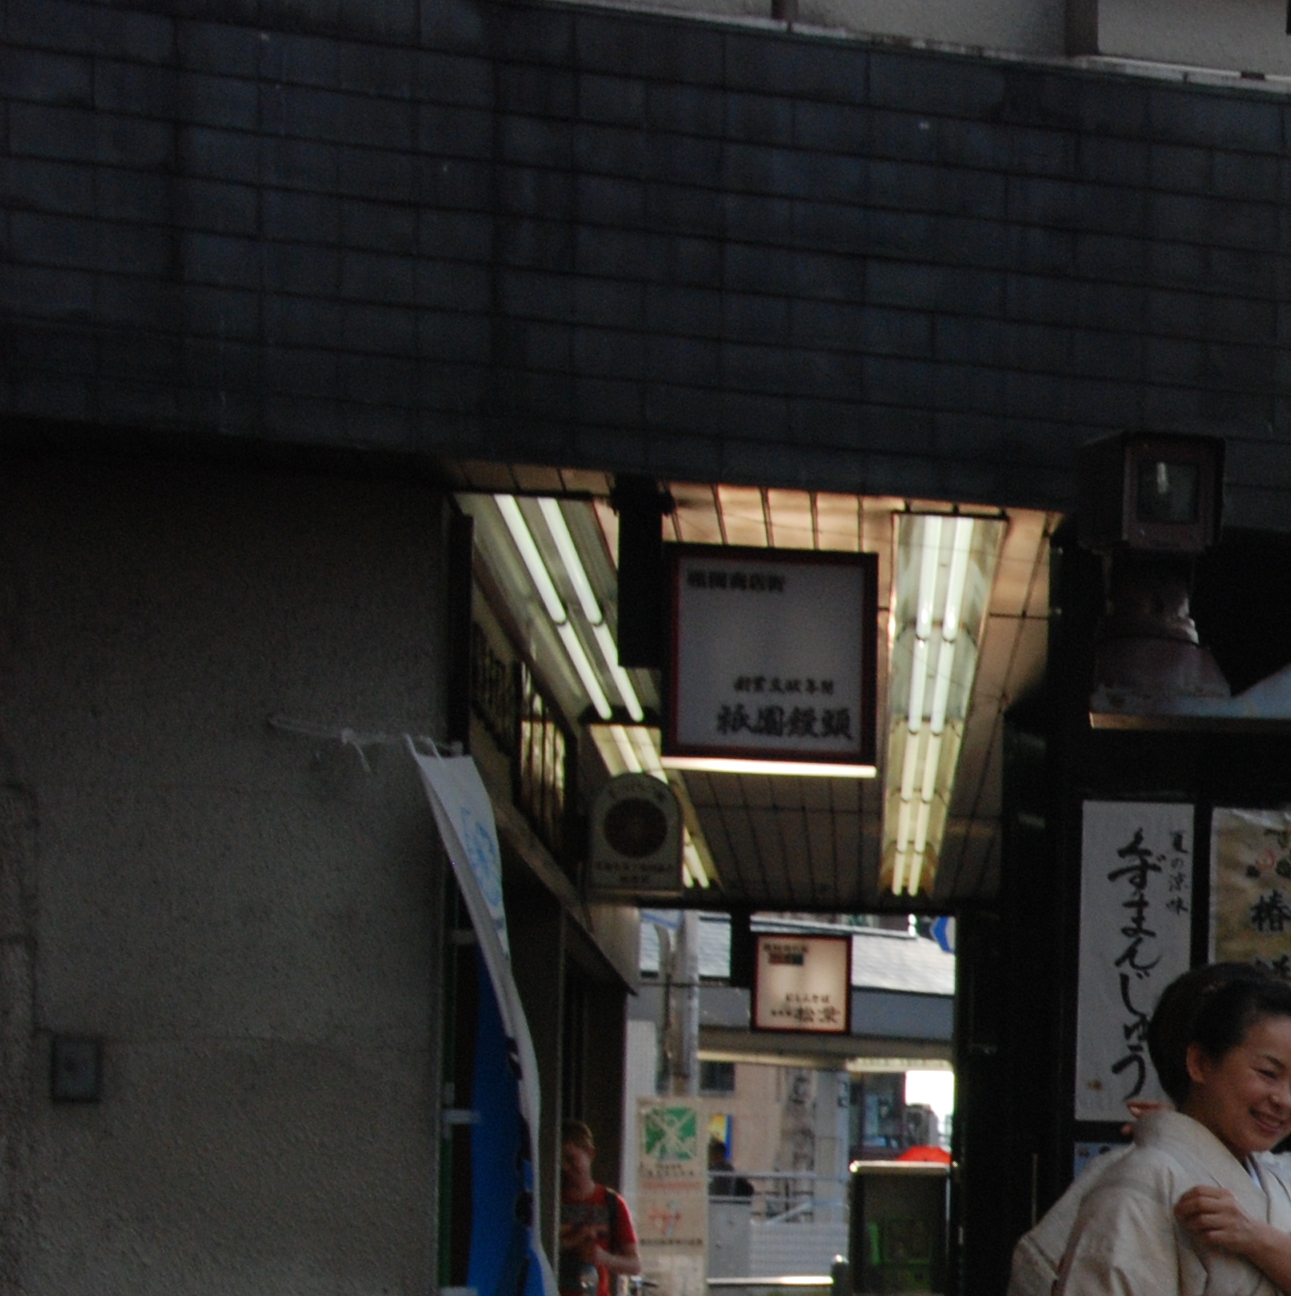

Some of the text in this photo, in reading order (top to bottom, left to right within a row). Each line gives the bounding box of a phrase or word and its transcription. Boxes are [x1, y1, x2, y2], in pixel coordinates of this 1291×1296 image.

[1108, 826, 1167, 1102] くずまんじゅう
